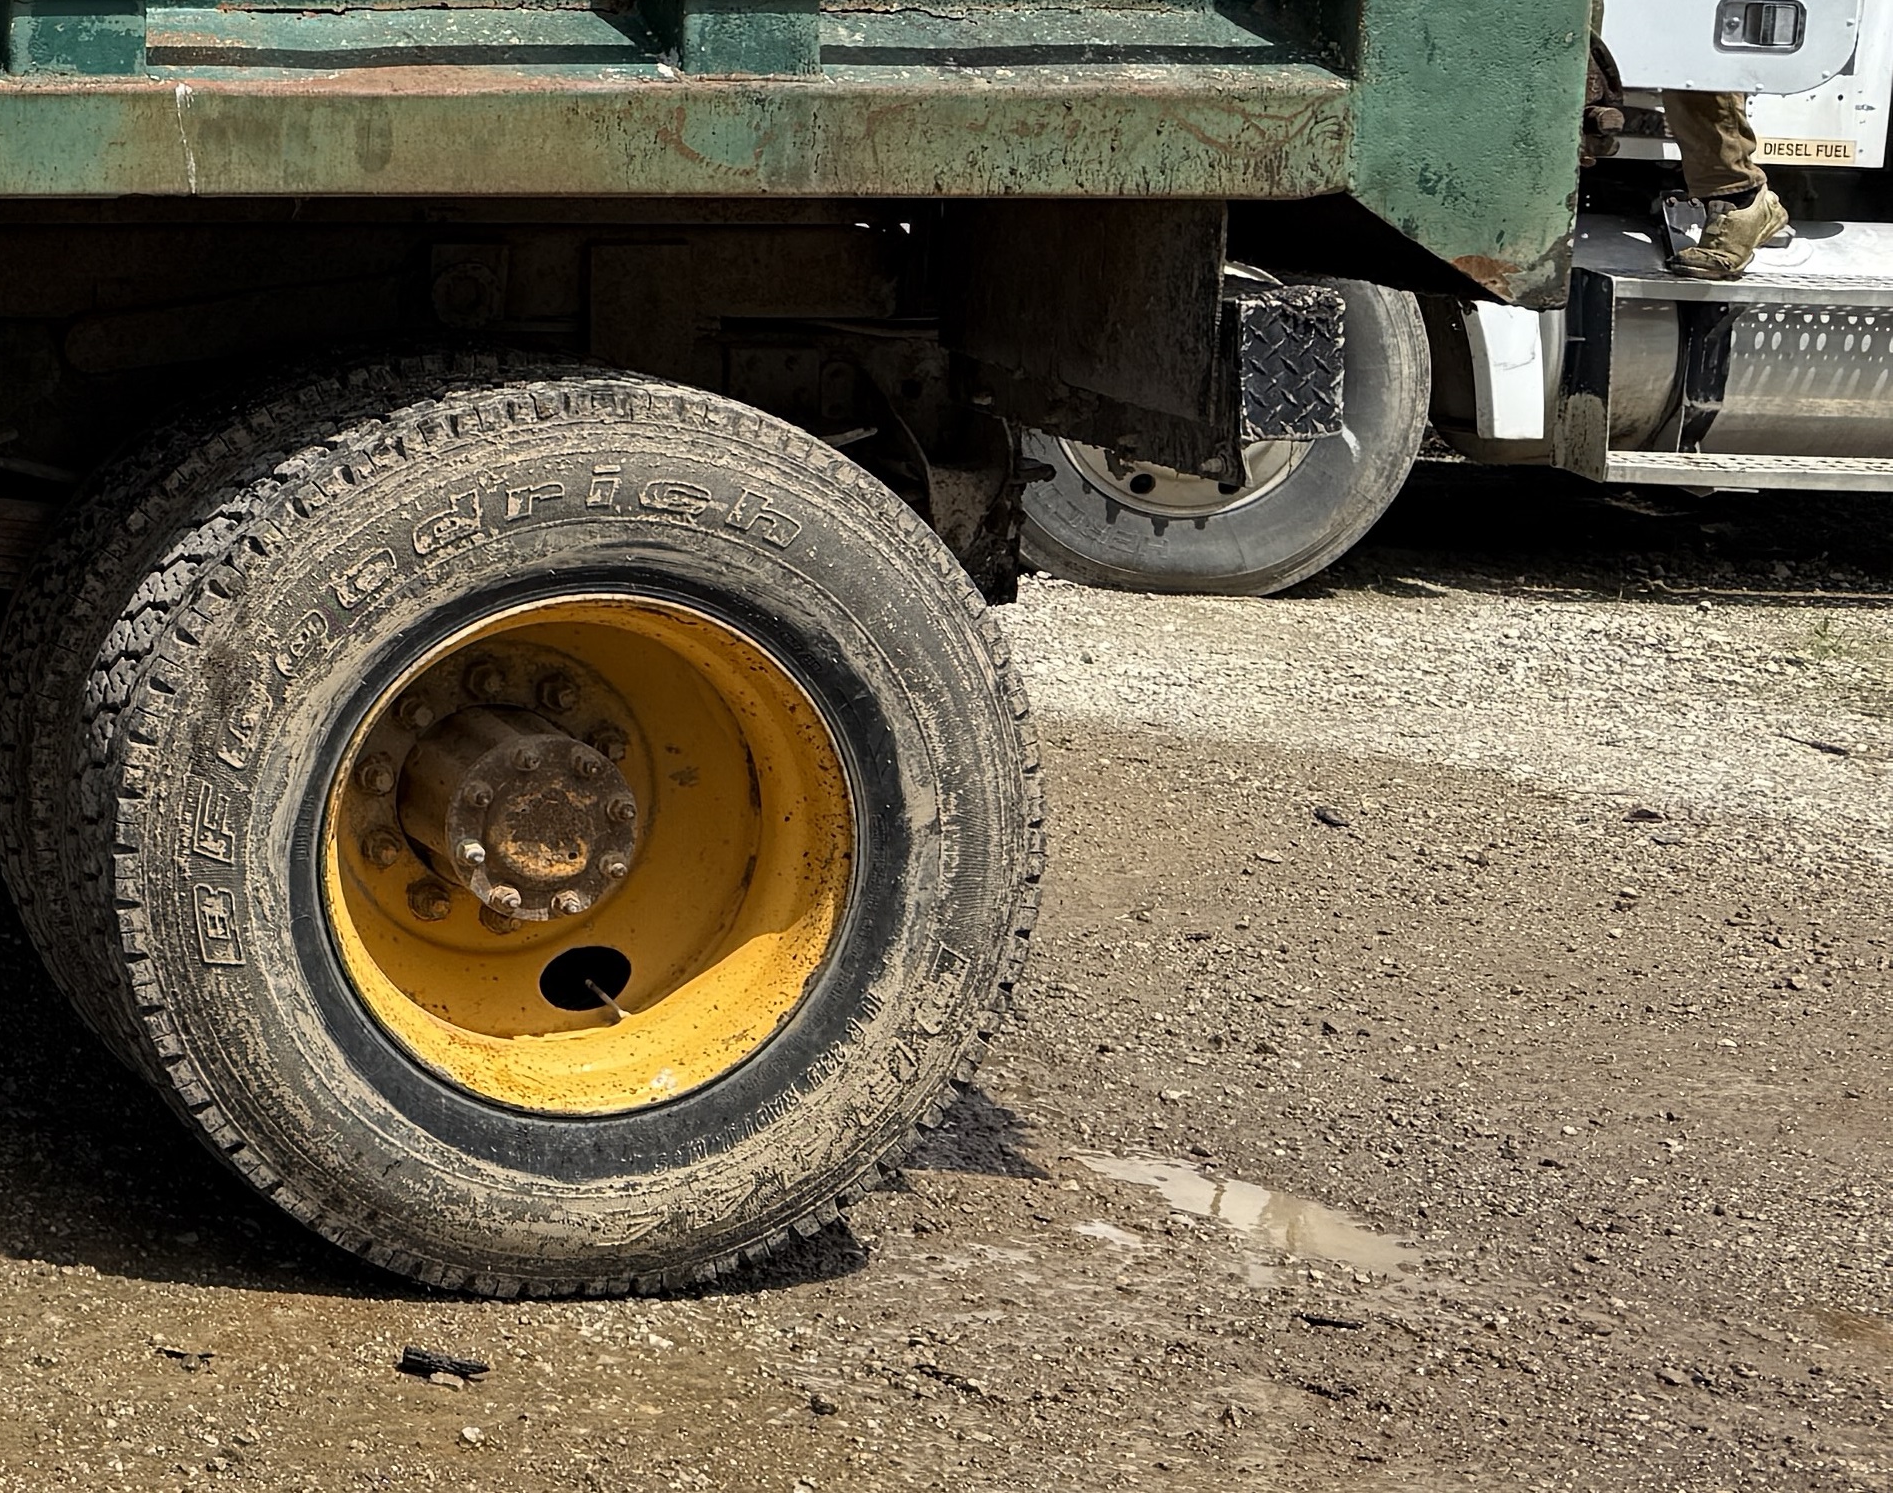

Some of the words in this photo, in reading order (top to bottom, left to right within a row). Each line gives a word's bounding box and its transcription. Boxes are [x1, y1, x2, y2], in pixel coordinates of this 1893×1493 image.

[1763, 142, 1812, 157] DIESEL
[1816, 144, 1852, 159] FUEL
[193, 466, 803, 966] BFGoodrich
